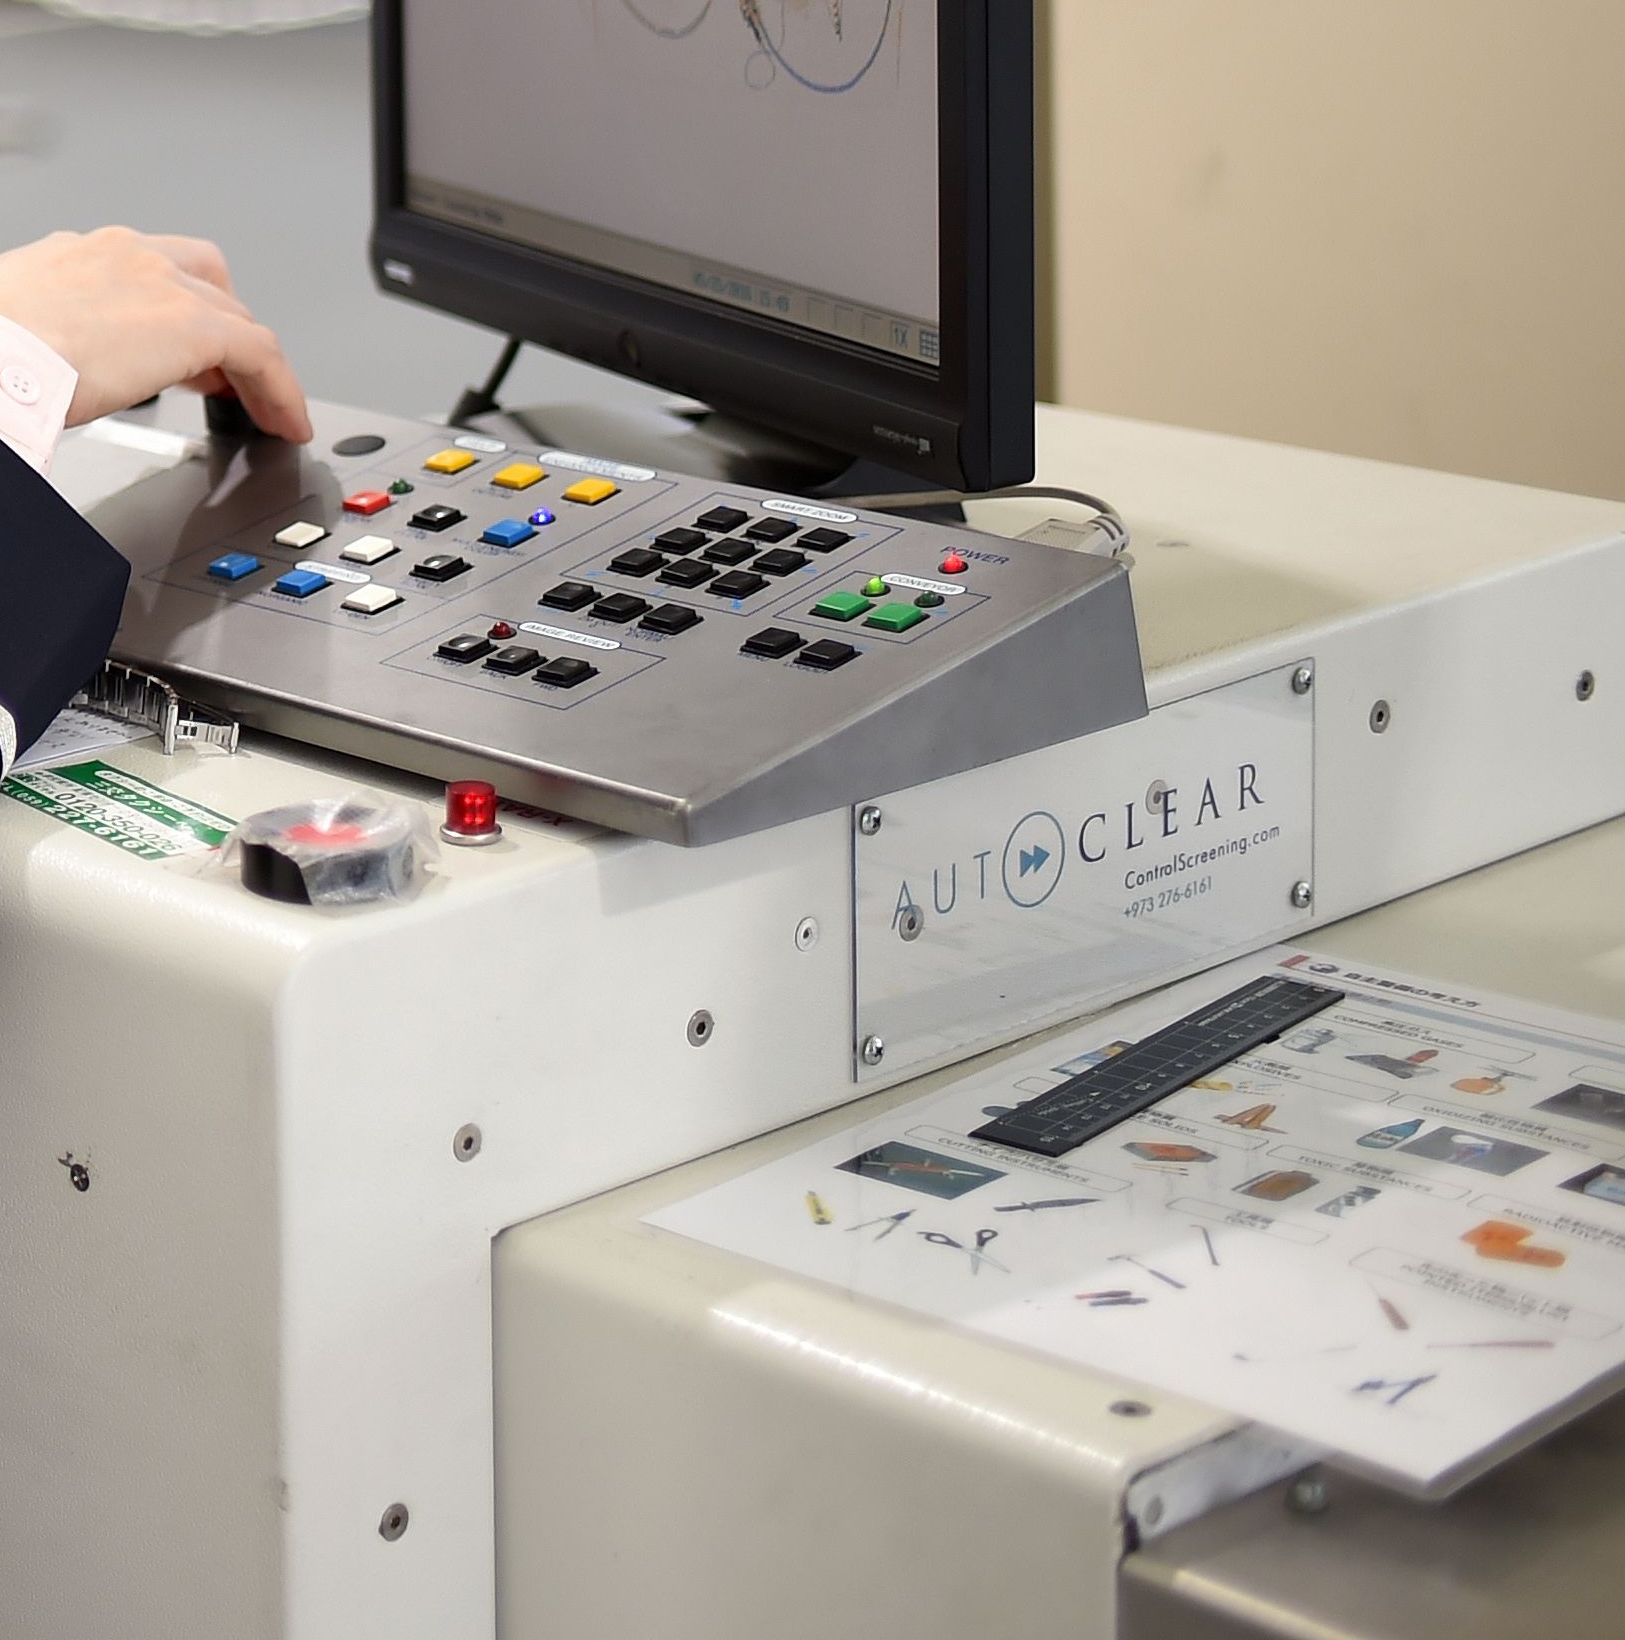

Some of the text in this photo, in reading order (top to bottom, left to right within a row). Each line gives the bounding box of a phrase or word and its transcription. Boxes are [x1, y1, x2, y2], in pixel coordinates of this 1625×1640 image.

[939, 545, 1010, 565] POWER
[888, 575, 962, 594] CONVEYOR
[523, 622, 615, 649] IMAGE REVIEW
[54, 792, 183, 851] 0120-350-026
[1123, 823, 1281, 890] ControlScreening.com
[1122, 876, 1213, 919] +973 276-6161
[1334, 1015, 1464, 1048] COMPRESSED GASES
[1498, 1123, 1591, 1150] SUBSTANCES
[937, 1137, 996, 1159] CUTTING
[998, 1153, 1091, 1184] INSTRUMENTS
[1298, 1155, 1340, 1169] TOXIC
